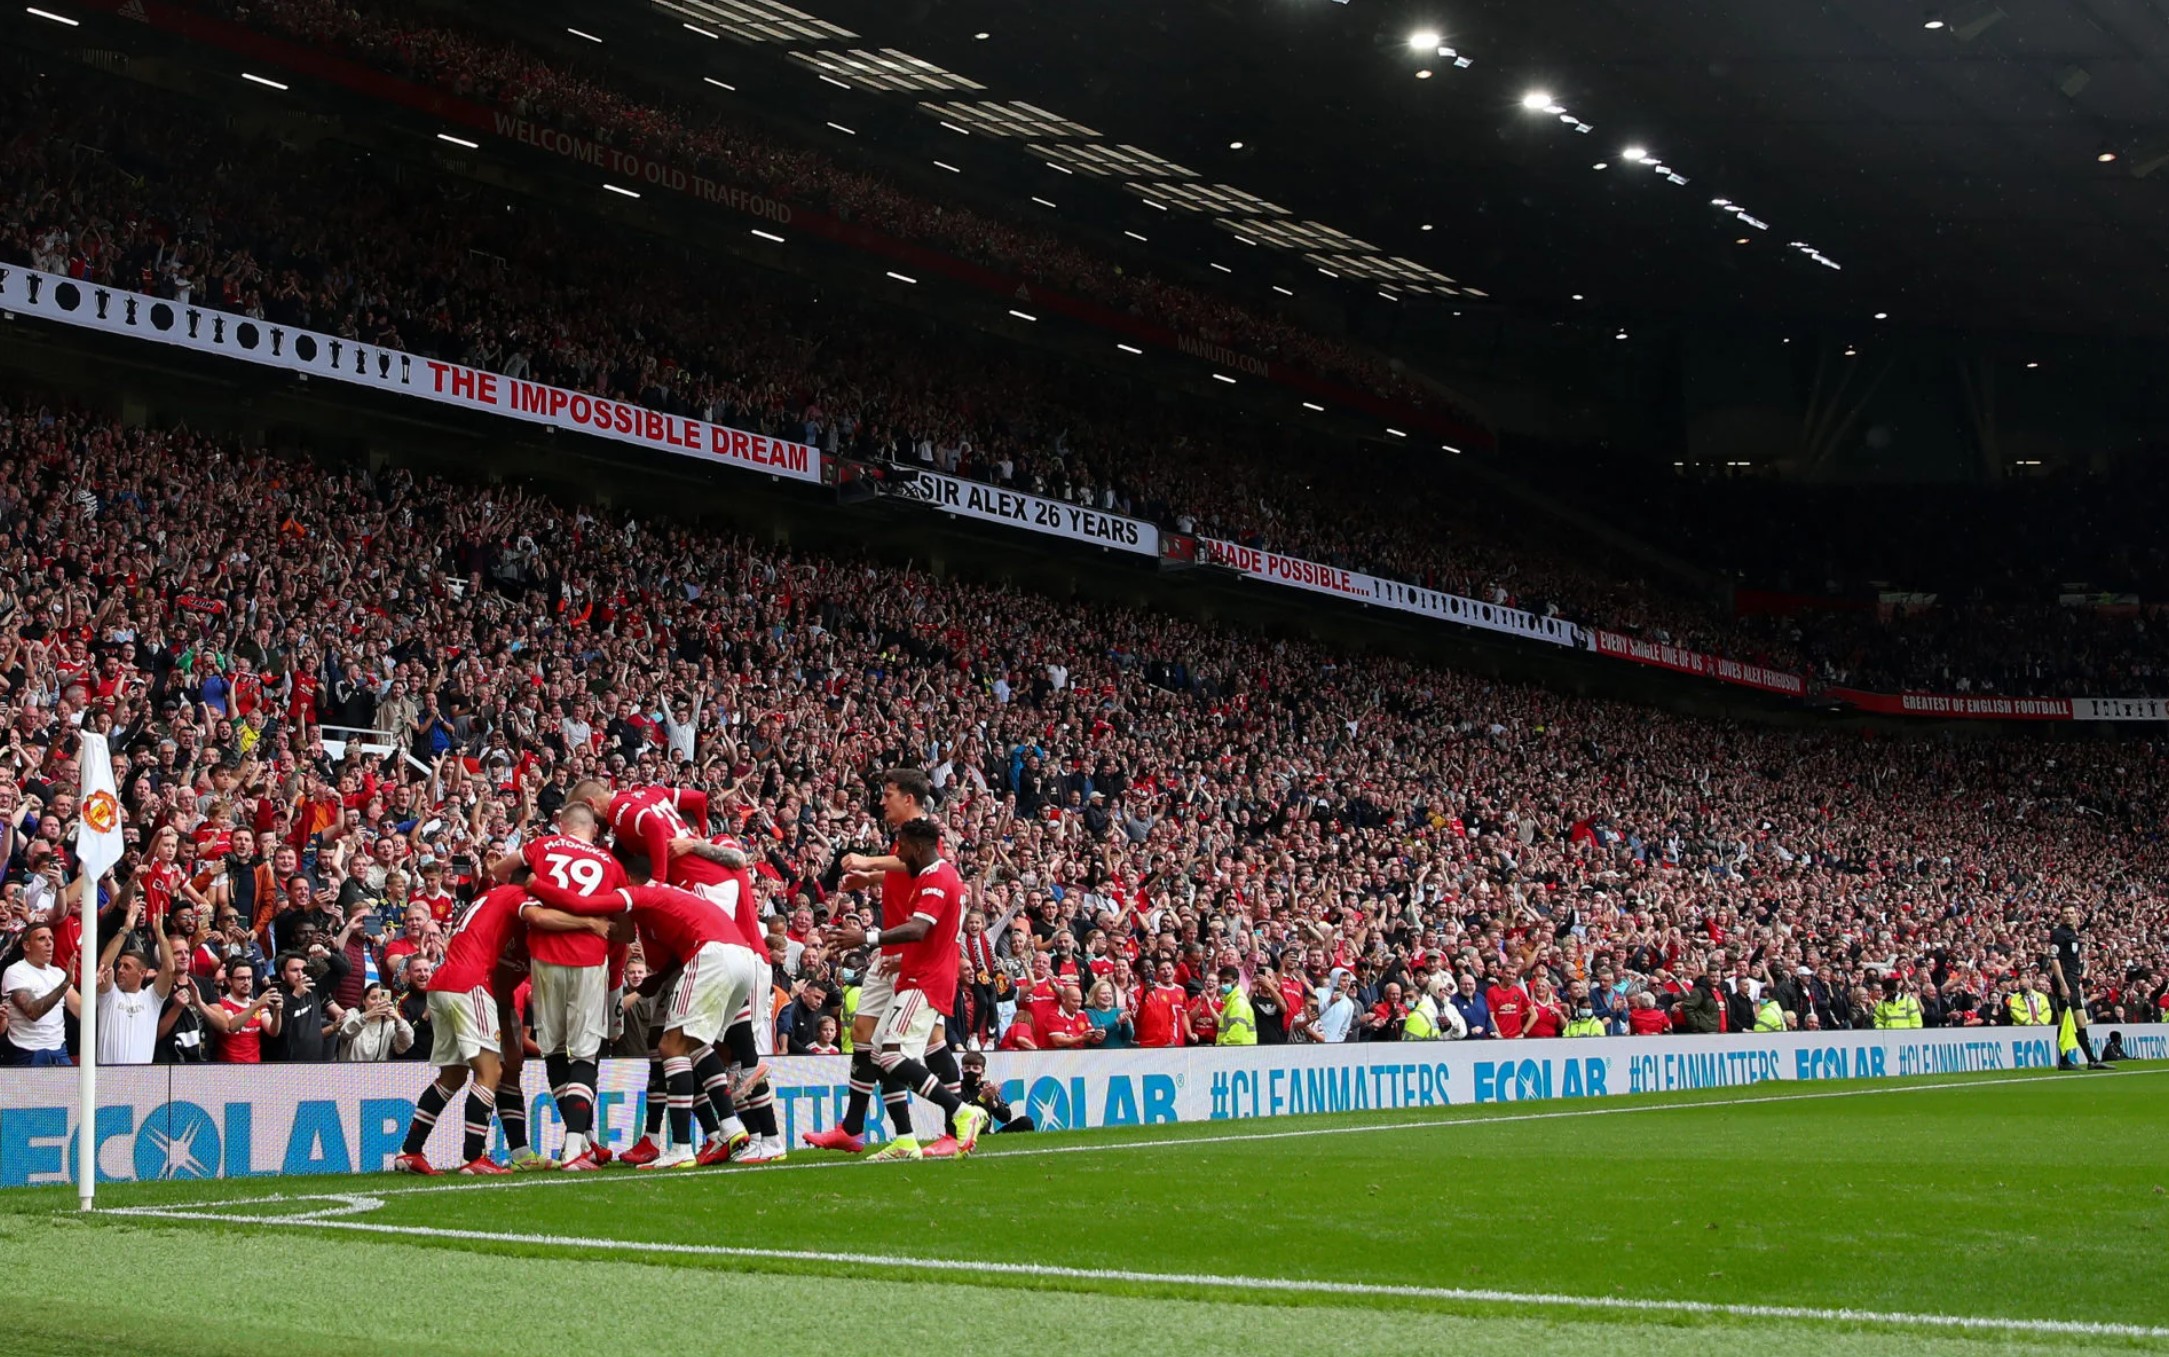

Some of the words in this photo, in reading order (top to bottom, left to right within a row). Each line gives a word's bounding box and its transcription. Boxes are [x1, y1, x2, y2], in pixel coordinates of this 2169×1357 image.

[494, 112, 604, 168] WELCOME
[608, 150, 639, 177] TO
[644, 161, 687, 191] OLD
[693, 176, 792, 225] TRAFFORD
[1177, 334, 1269, 378] MANUTD.COM
[427, 361, 498, 405] THE
[510, 380, 702, 449] IMPOSSIBLE
[711, 426, 809, 473] DREAM
[920, 474, 960, 507] SIR
[967, 486, 1028, 522] ALEX
[1034, 501, 1061, 528] 26
[1067, 507, 1139, 546] YEARS
[1207, 540, 1262, 573] MADE
[1600, 630, 1628, 654] EVERY
[1661, 645, 1678, 666] ONE
[1691, 652, 1703, 671] US
[1718, 659, 1742, 680] LOVES
[1743, 664, 1761, 683] ALEX
[1762, 668, 1801, 693] FERGUSON
[1902, 695, 1950, 711] GREATEST
[1952, 697, 1965, 712] OF
[1967, 698, 2012, 713] ENGLISH
[2015, 700, 2069, 715] FOOTBALL
[544, 852, 604, 897] 39
[614, 998, 624, 1018] 6
[1630, 1049, 1779, 1094] #CLEANMATTERS
[1898, 1041, 2004, 1075] #CLEANMATTERS
[1210, 1062, 1450, 1119] #CLEANMATTERS
